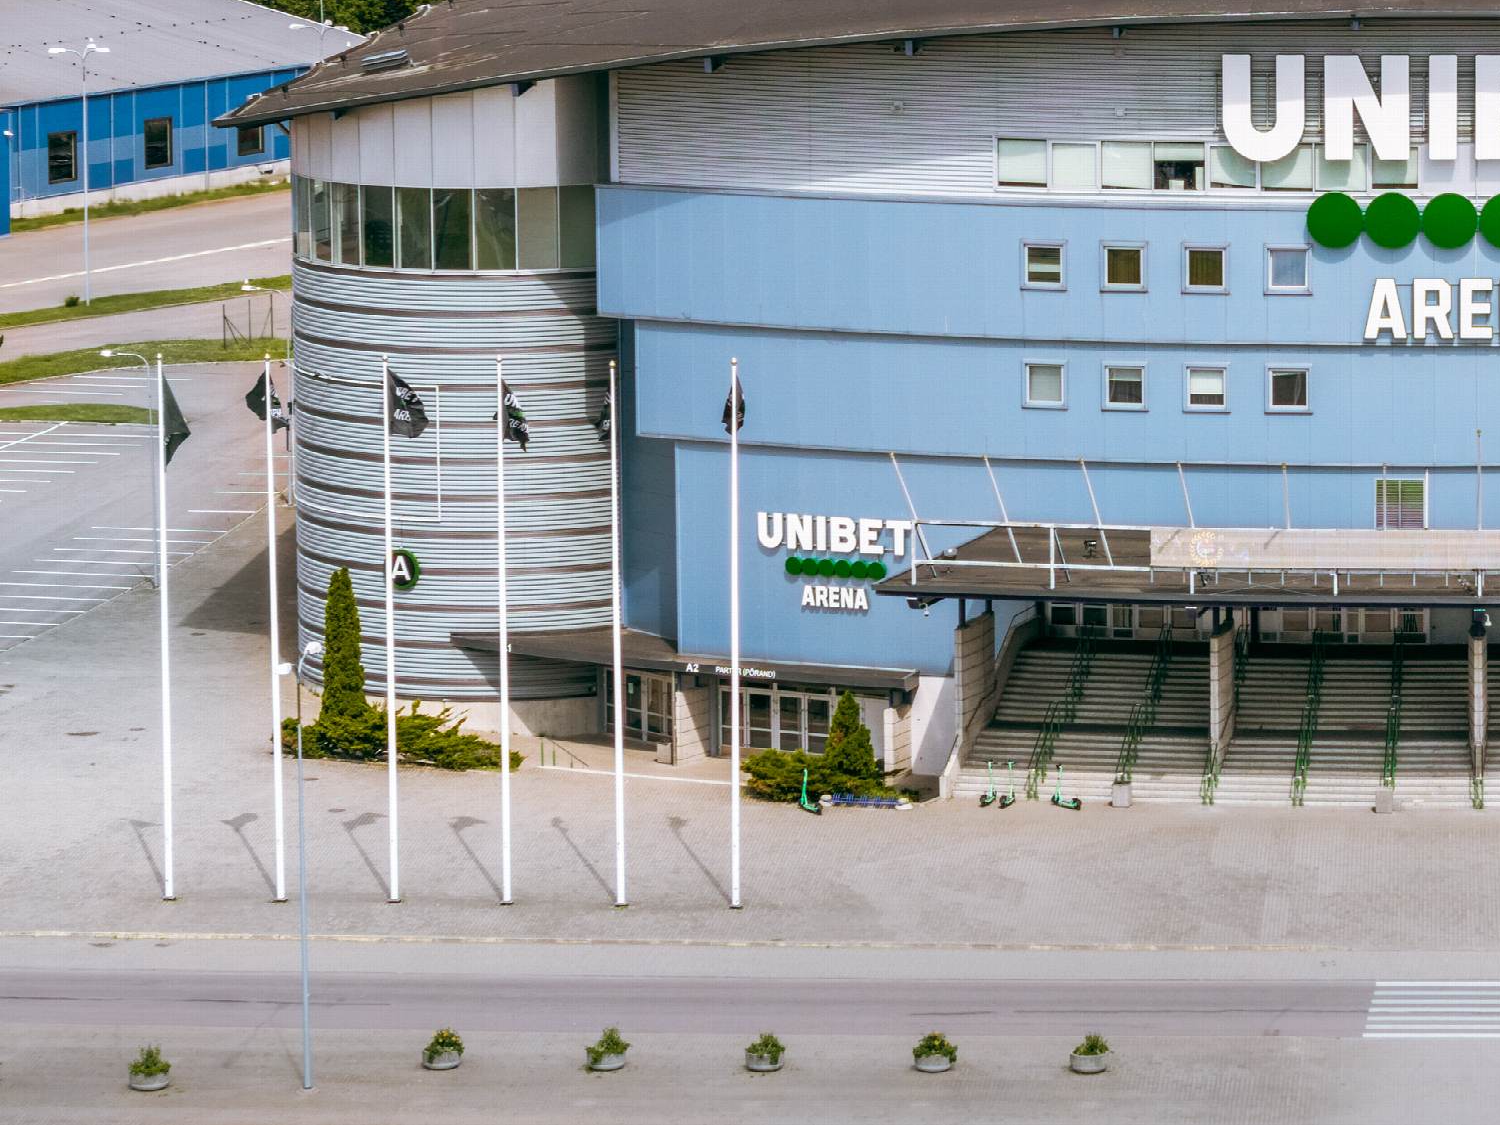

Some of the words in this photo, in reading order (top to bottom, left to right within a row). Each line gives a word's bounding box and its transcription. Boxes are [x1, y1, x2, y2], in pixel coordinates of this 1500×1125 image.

[757, 511, 912, 557] UNIBET
[391, 555, 411, 581] A
[801, 584, 869, 611] ARENA
[685, 662, 700, 673] A2
[715, 665, 742, 676] PARTR
